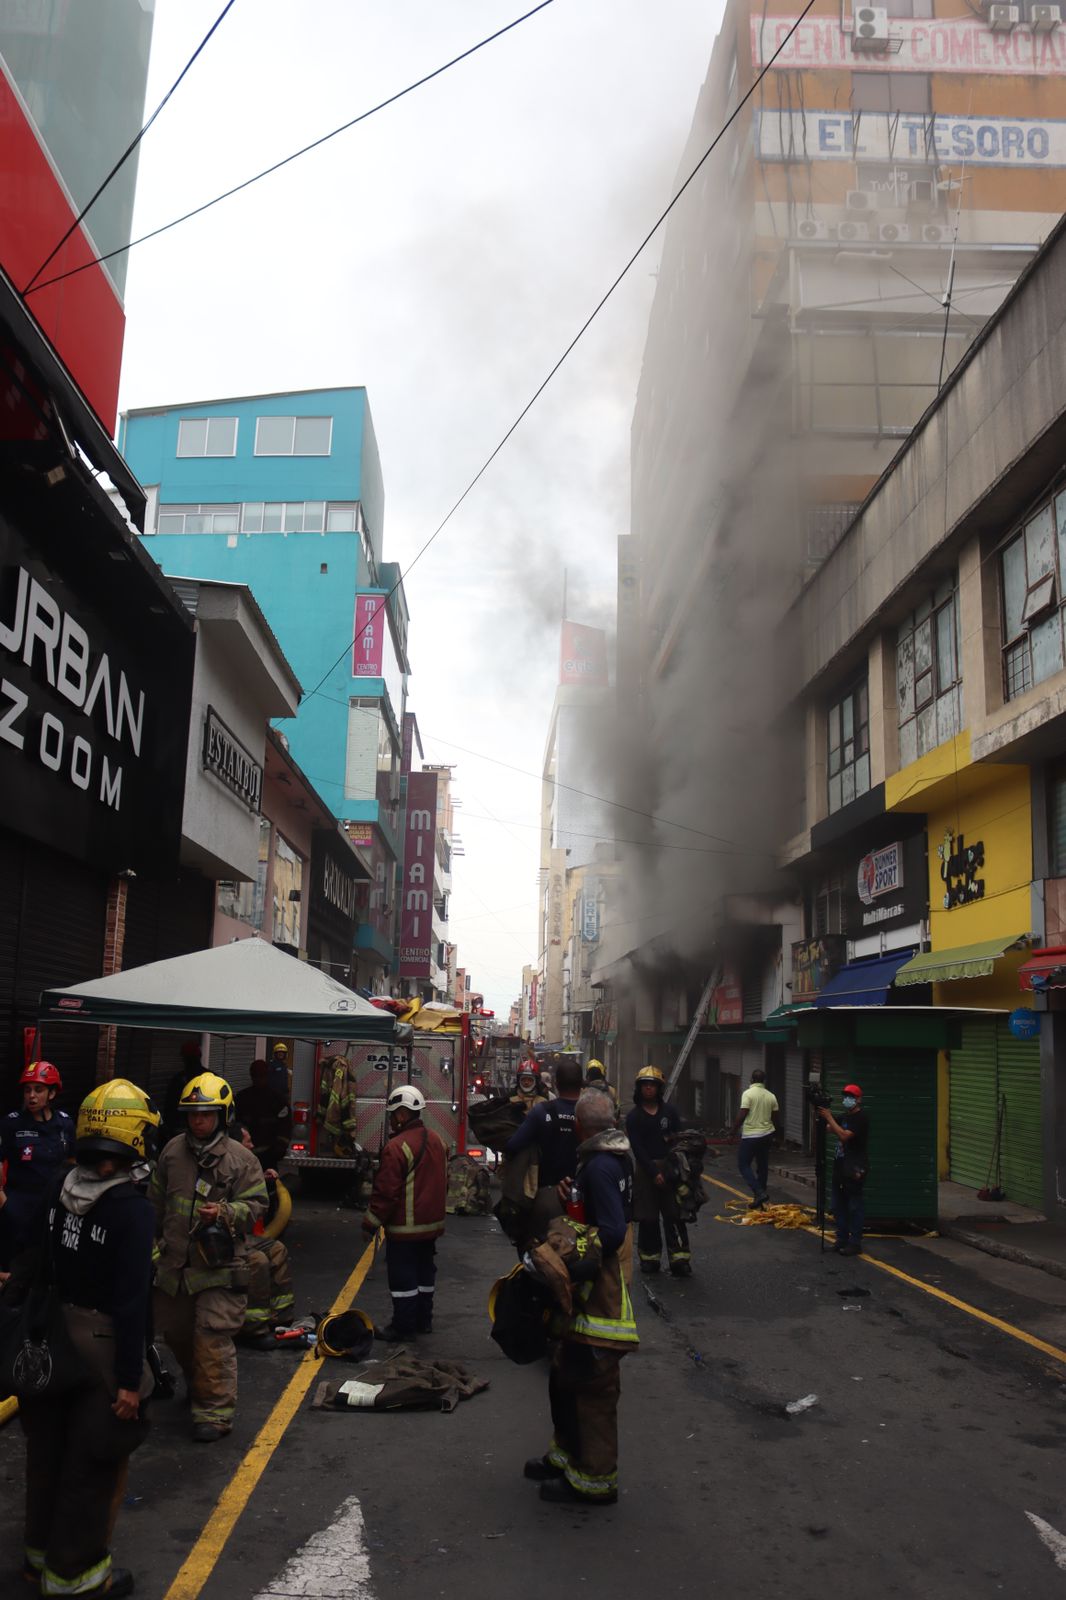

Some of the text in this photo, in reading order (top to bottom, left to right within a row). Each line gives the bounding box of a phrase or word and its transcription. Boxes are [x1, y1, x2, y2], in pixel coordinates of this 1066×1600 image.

[909, 26, 1066, 69] COMERCIA
[819, 120, 1049, 159] EL TESORO
[363, 600, 376, 661] MIAMI
[0, 678, 123, 811] ZOOM
[406, 810, 431, 938] MIAMI
[875, 850, 897, 869] RUNNER
[875, 865, 897, 889] SPORT
[400, 947, 430, 957] CENTRO
